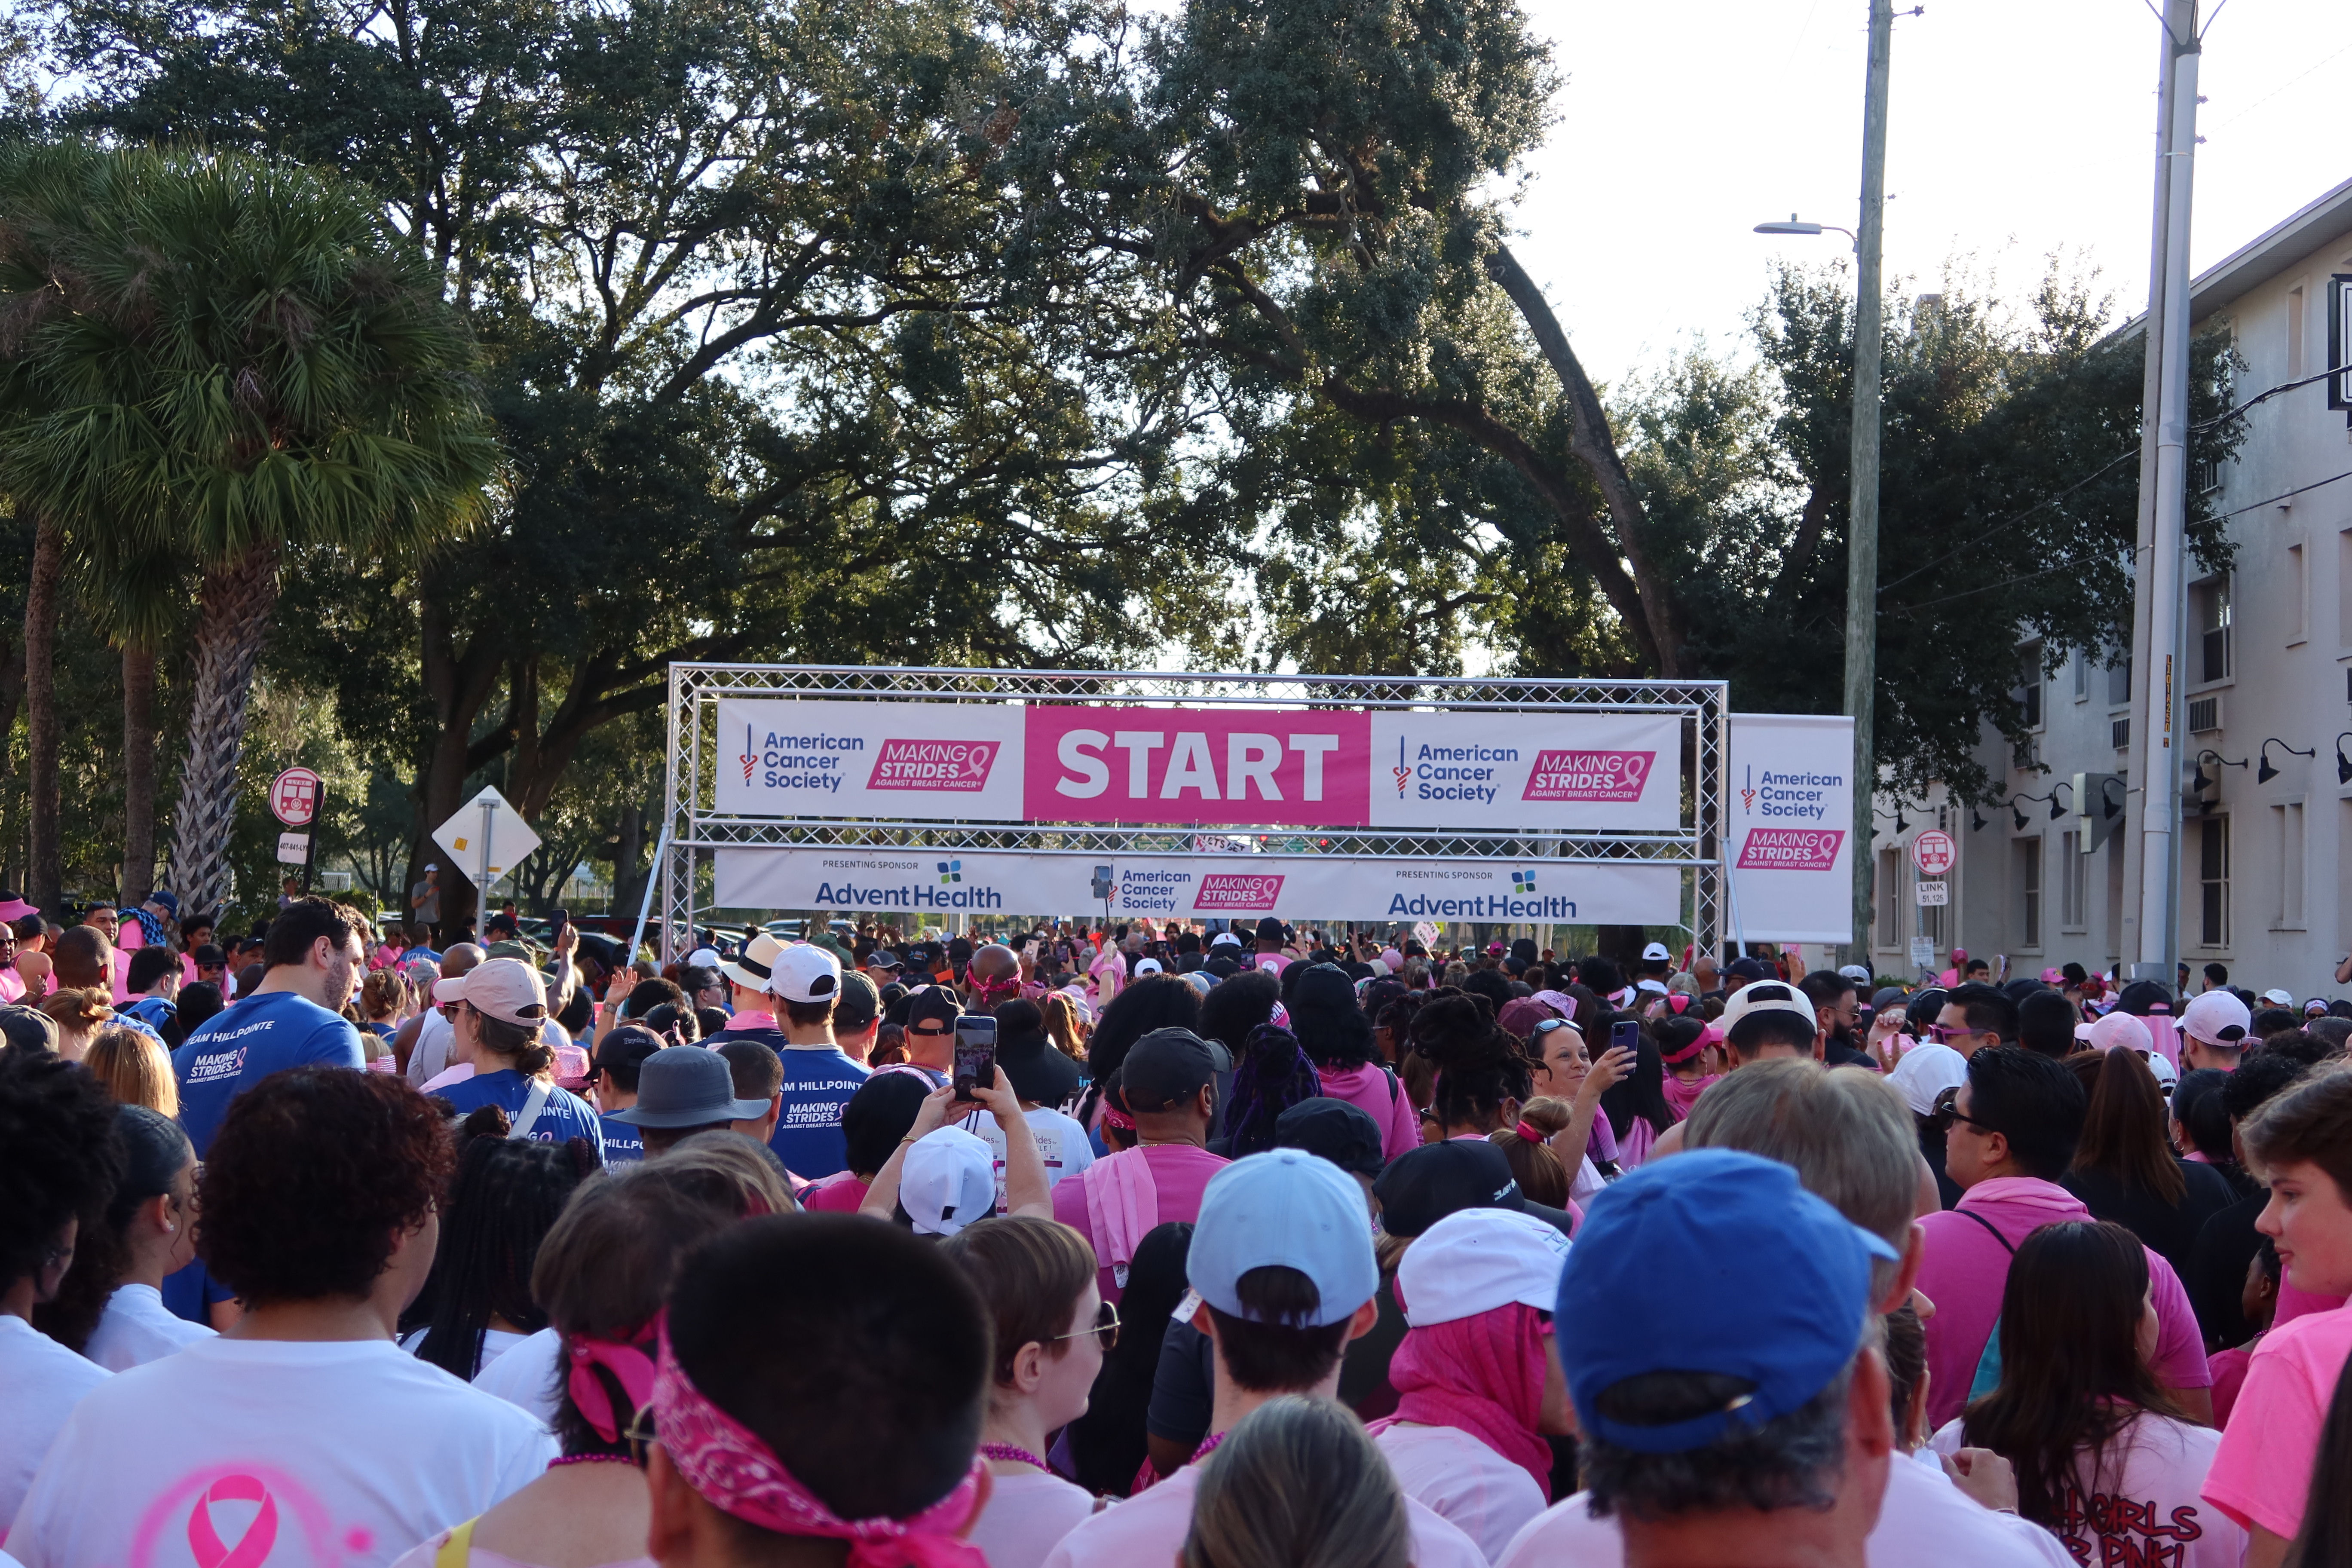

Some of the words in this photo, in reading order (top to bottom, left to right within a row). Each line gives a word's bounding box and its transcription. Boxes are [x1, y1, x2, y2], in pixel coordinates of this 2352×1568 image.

[764, 732, 863, 750] American
[764, 751, 839, 769] Cancer
[886, 744, 968, 762] MAKING
[1418, 744, 1518, 761] American
[881, 763, 959, 778] STRIDES
[1055, 729, 1338, 801] START
[1542, 755, 1622, 772] MAKING
[1418, 763, 1494, 780] Cancer
[1761, 771, 1842, 786] American
[1535, 774, 1616, 789] STRIDES
[1761, 787, 1822, 801] Cancer
[1753, 832, 1818, 846] MAKING
[1748, 847, 1812, 860] STRIDES
[1123, 870, 1190, 882] American
[1207, 878, 1262, 889] MAKING
[814, 882, 1001, 908] AdventHealth
[1122, 883, 1174, 895] Cancer
[1921, 883, 1944, 892] LINK
[1203, 890, 1257, 901] STRIDES
[1388, 893, 1576, 918] AdventHealth
[186, 1033, 211, 1047] TEAM
[212, 1021, 275, 1042] HILLPOINTE
[195, 1049, 238, 1066] MAKING
[190, 1061, 233, 1078] STRIDES
[207, 1074, 224, 1082] BREAST
[789, 1102, 838, 1114] MAKING
[786, 1112, 834, 1123] STRIDES
[2090, 1493, 2202, 1541] GIRLS
